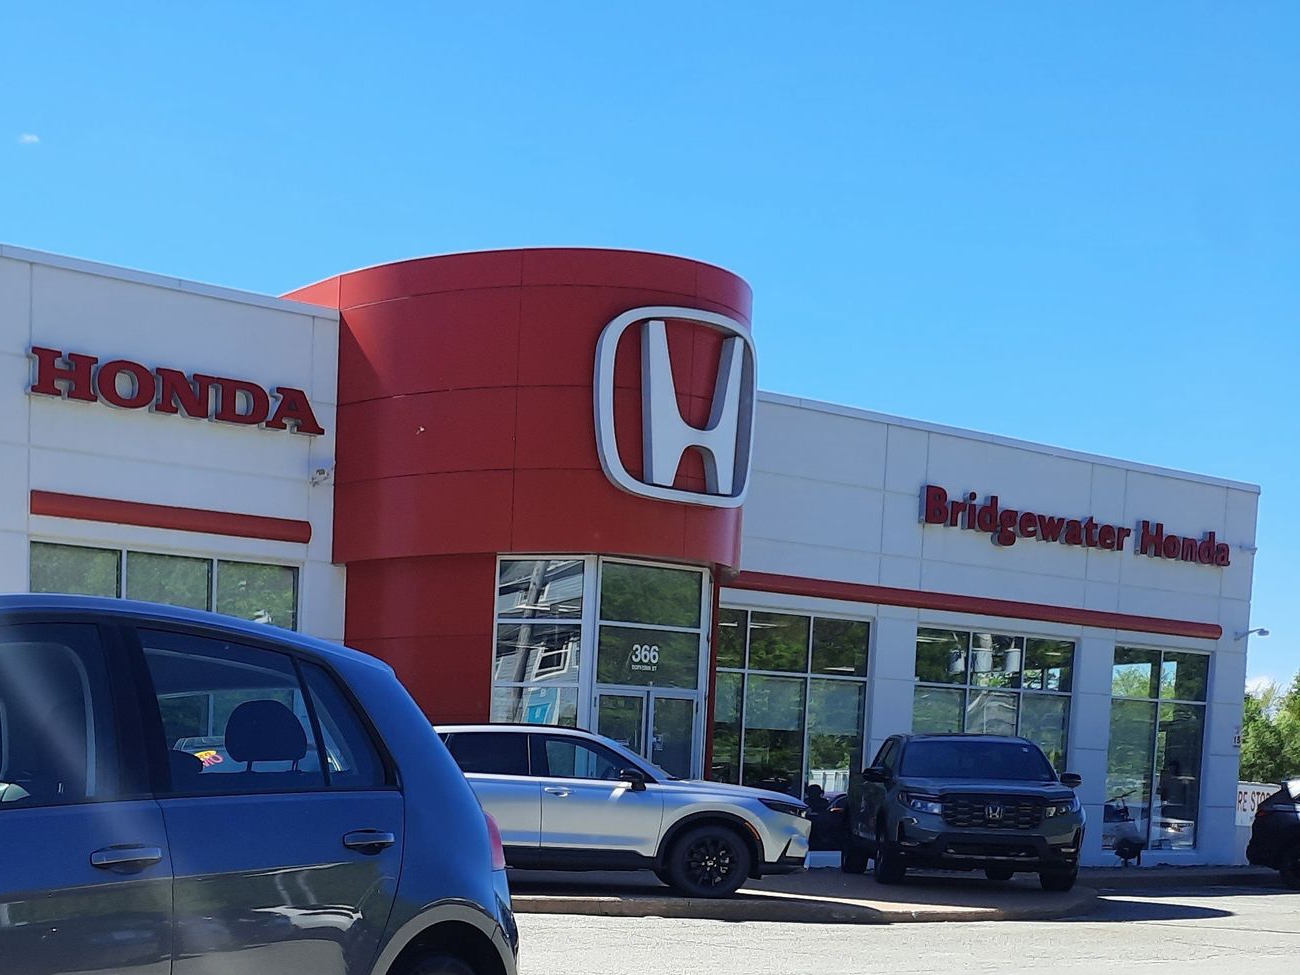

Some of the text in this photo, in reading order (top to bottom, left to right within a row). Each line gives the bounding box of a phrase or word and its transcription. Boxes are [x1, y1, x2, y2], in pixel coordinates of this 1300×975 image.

[29, 346, 325, 437] HONDA
[919, 484, 1231, 567] Bridgewater Honda
[632, 644, 659, 664] 366
